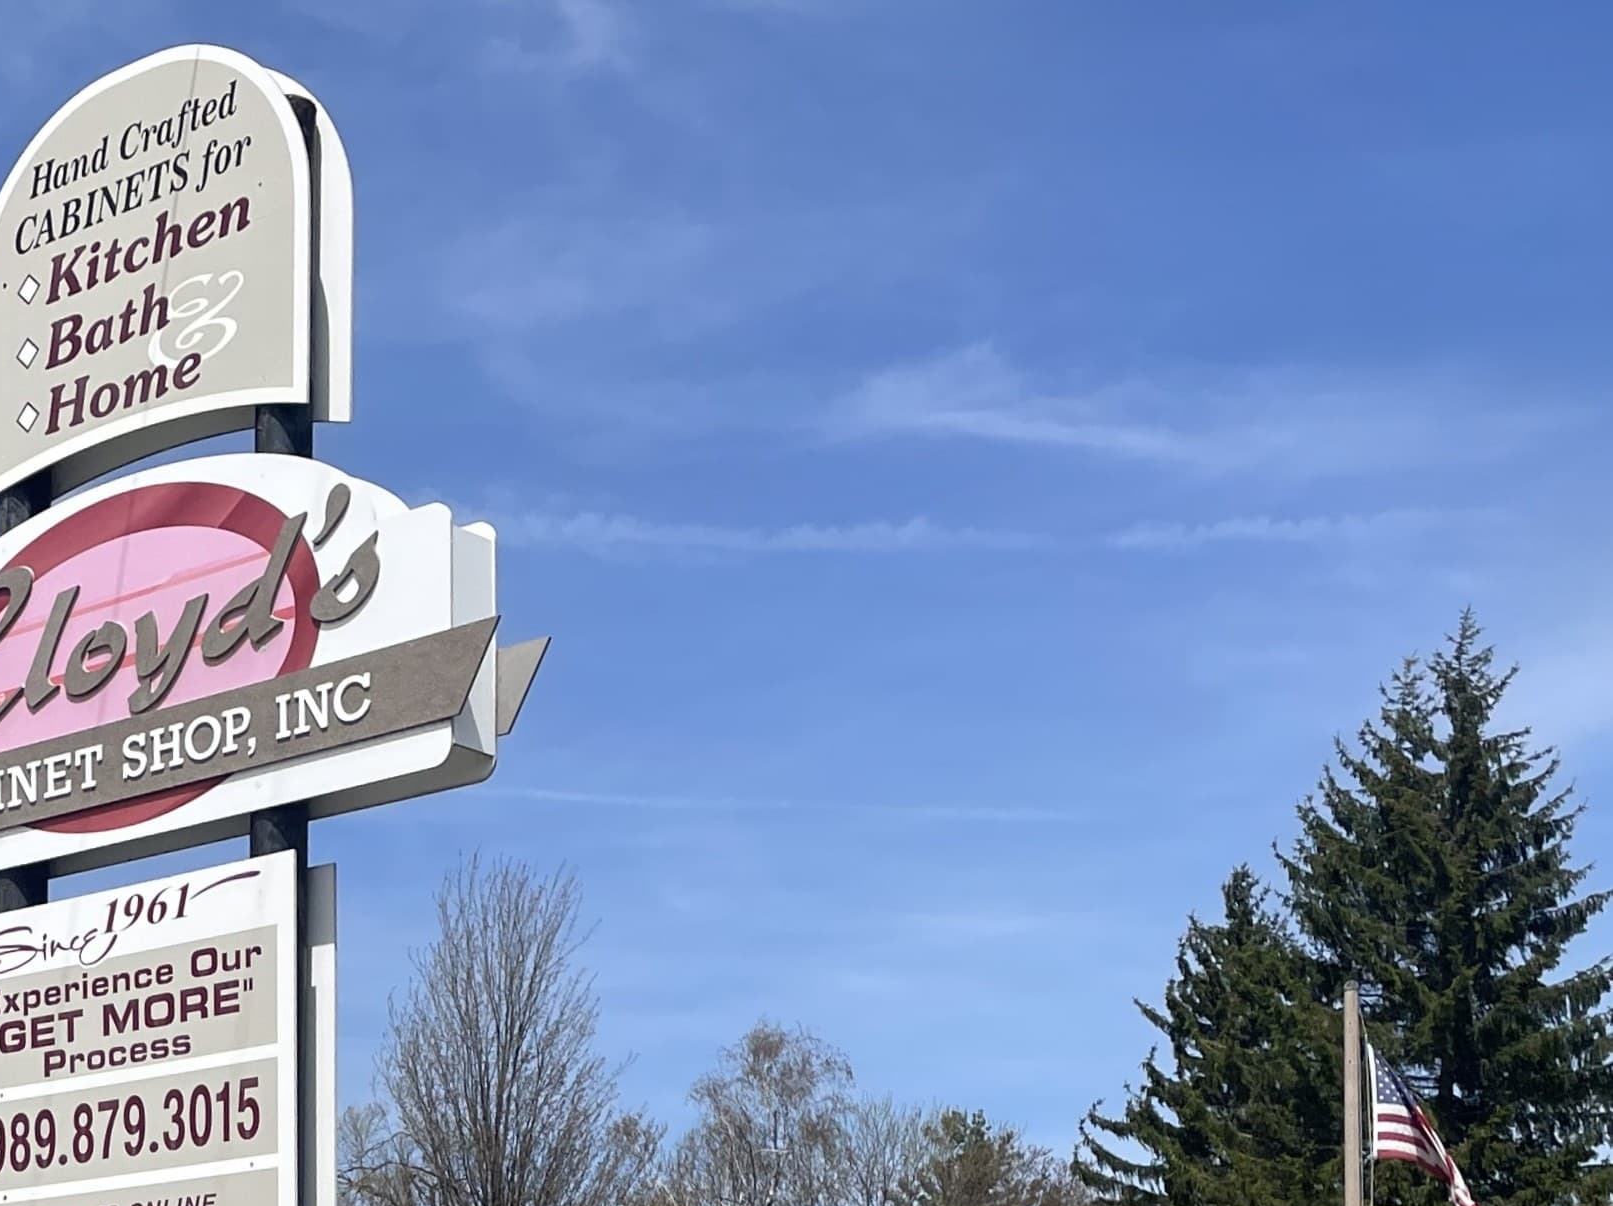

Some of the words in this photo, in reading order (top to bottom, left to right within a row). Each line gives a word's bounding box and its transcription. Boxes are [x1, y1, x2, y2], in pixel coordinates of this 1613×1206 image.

[30, 136, 108, 199] Hand
[119, 80, 238, 161] Crafted
[15, 151, 190, 255] CABINETS
[196, 136, 252, 192] for
[45, 197, 250, 305] Kitchen
[45, 282, 170, 370] Bath
[45, 352, 202, 435] Home
[121, 707, 258, 782] SHOP,
[274, 672, 373, 743] INC
[100, 882, 191, 935] 1961
[190, 945, 262, 978] Our
[102, 977, 254, 1037] MORE"
[43, 1034, 192, 1077] Process
